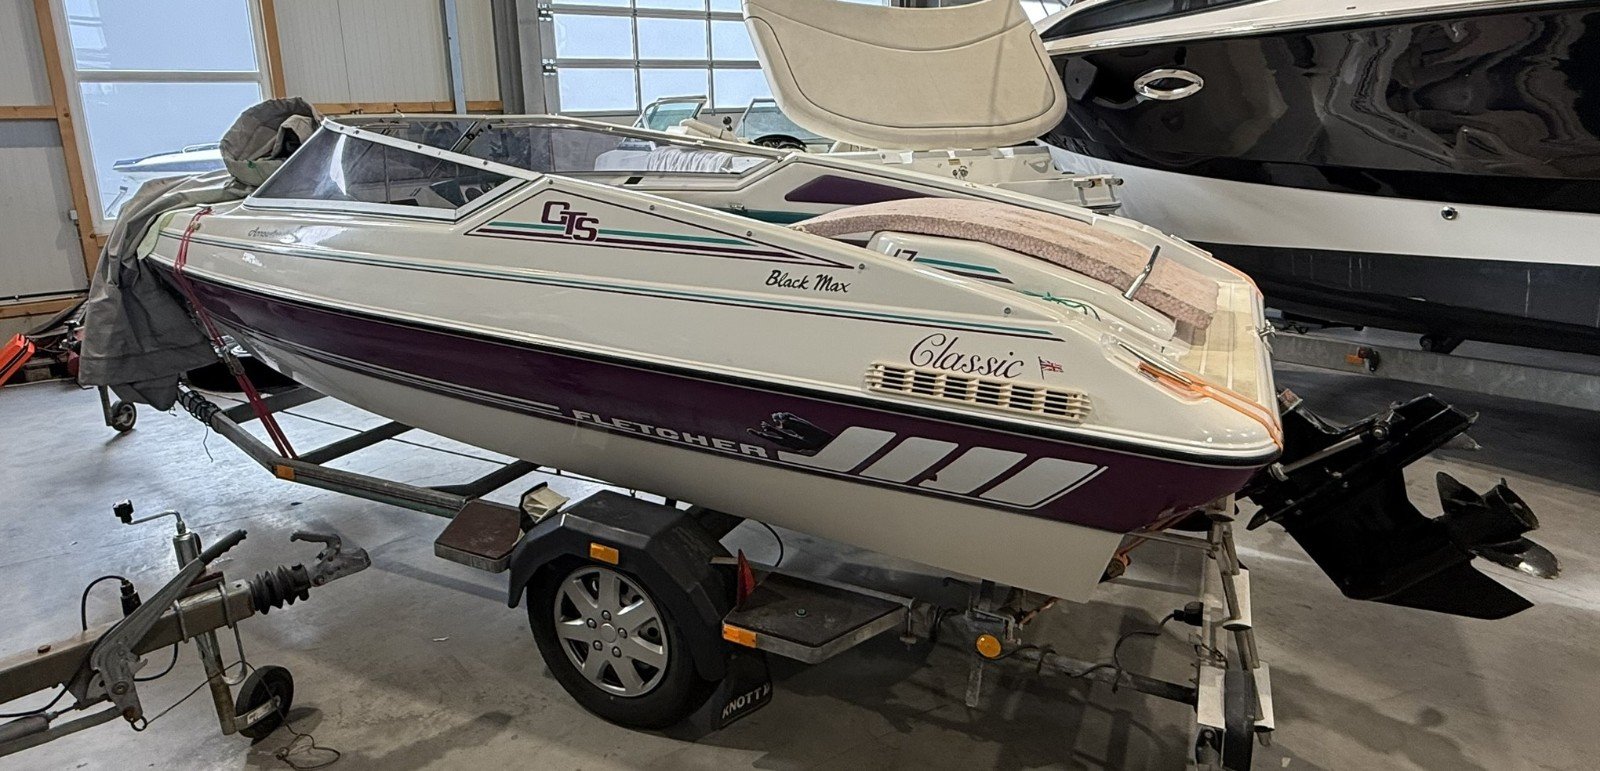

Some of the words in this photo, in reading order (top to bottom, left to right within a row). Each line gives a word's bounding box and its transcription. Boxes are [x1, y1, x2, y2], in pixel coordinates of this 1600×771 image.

[541, 201, 599, 241] GTS
[893, 249, 918, 262] 17
[765, 269, 810, 290] Black
[813, 274, 851, 293] Max
[909, 333, 1025, 379] Classic
[572, 409, 768, 458] FLETCHER
[721, 687, 762, 719] KNOTT
